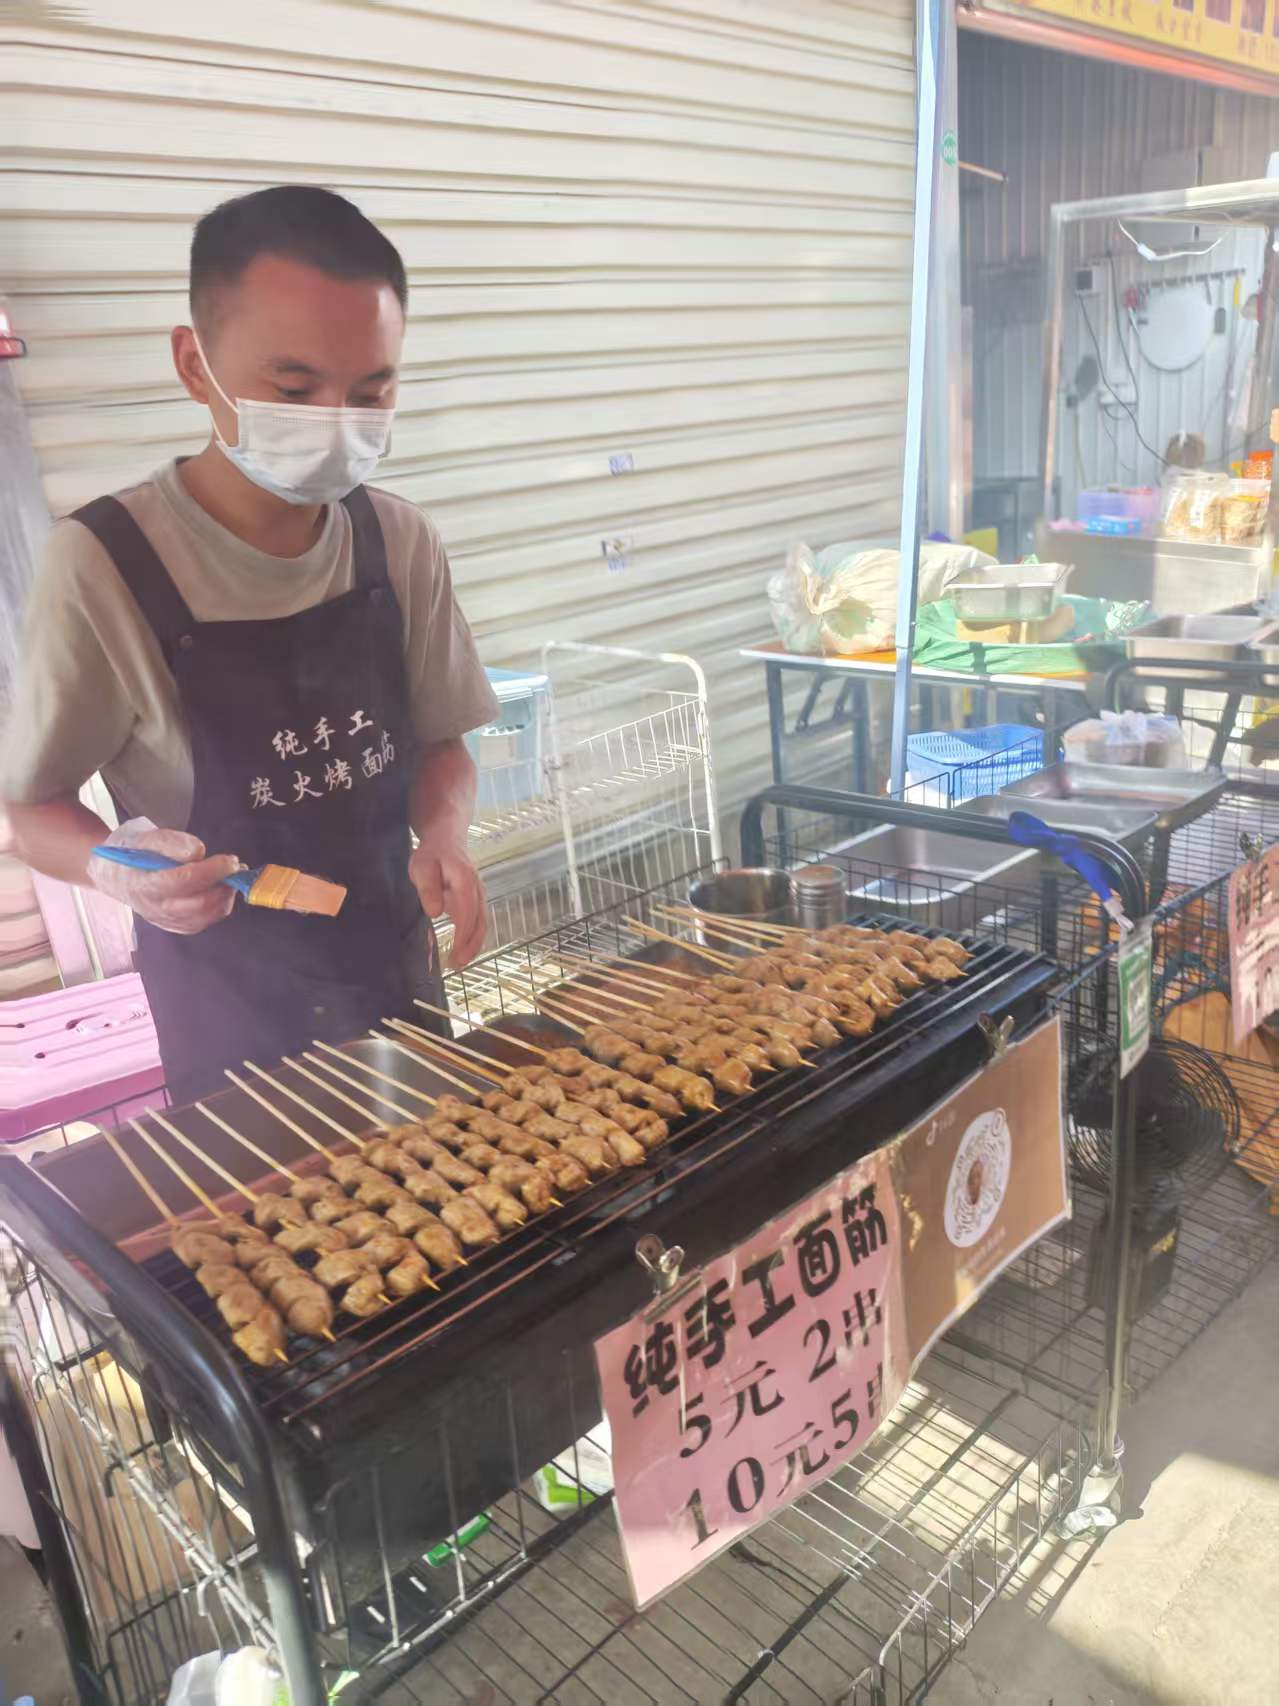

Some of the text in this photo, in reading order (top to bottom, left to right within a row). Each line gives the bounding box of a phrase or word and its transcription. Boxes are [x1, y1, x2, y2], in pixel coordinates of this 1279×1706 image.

[272, 710, 374, 760] 纯手工
[623, 1184, 888, 1418] 纯手工面筋
[679, 1360, 785, 1459] 5元
